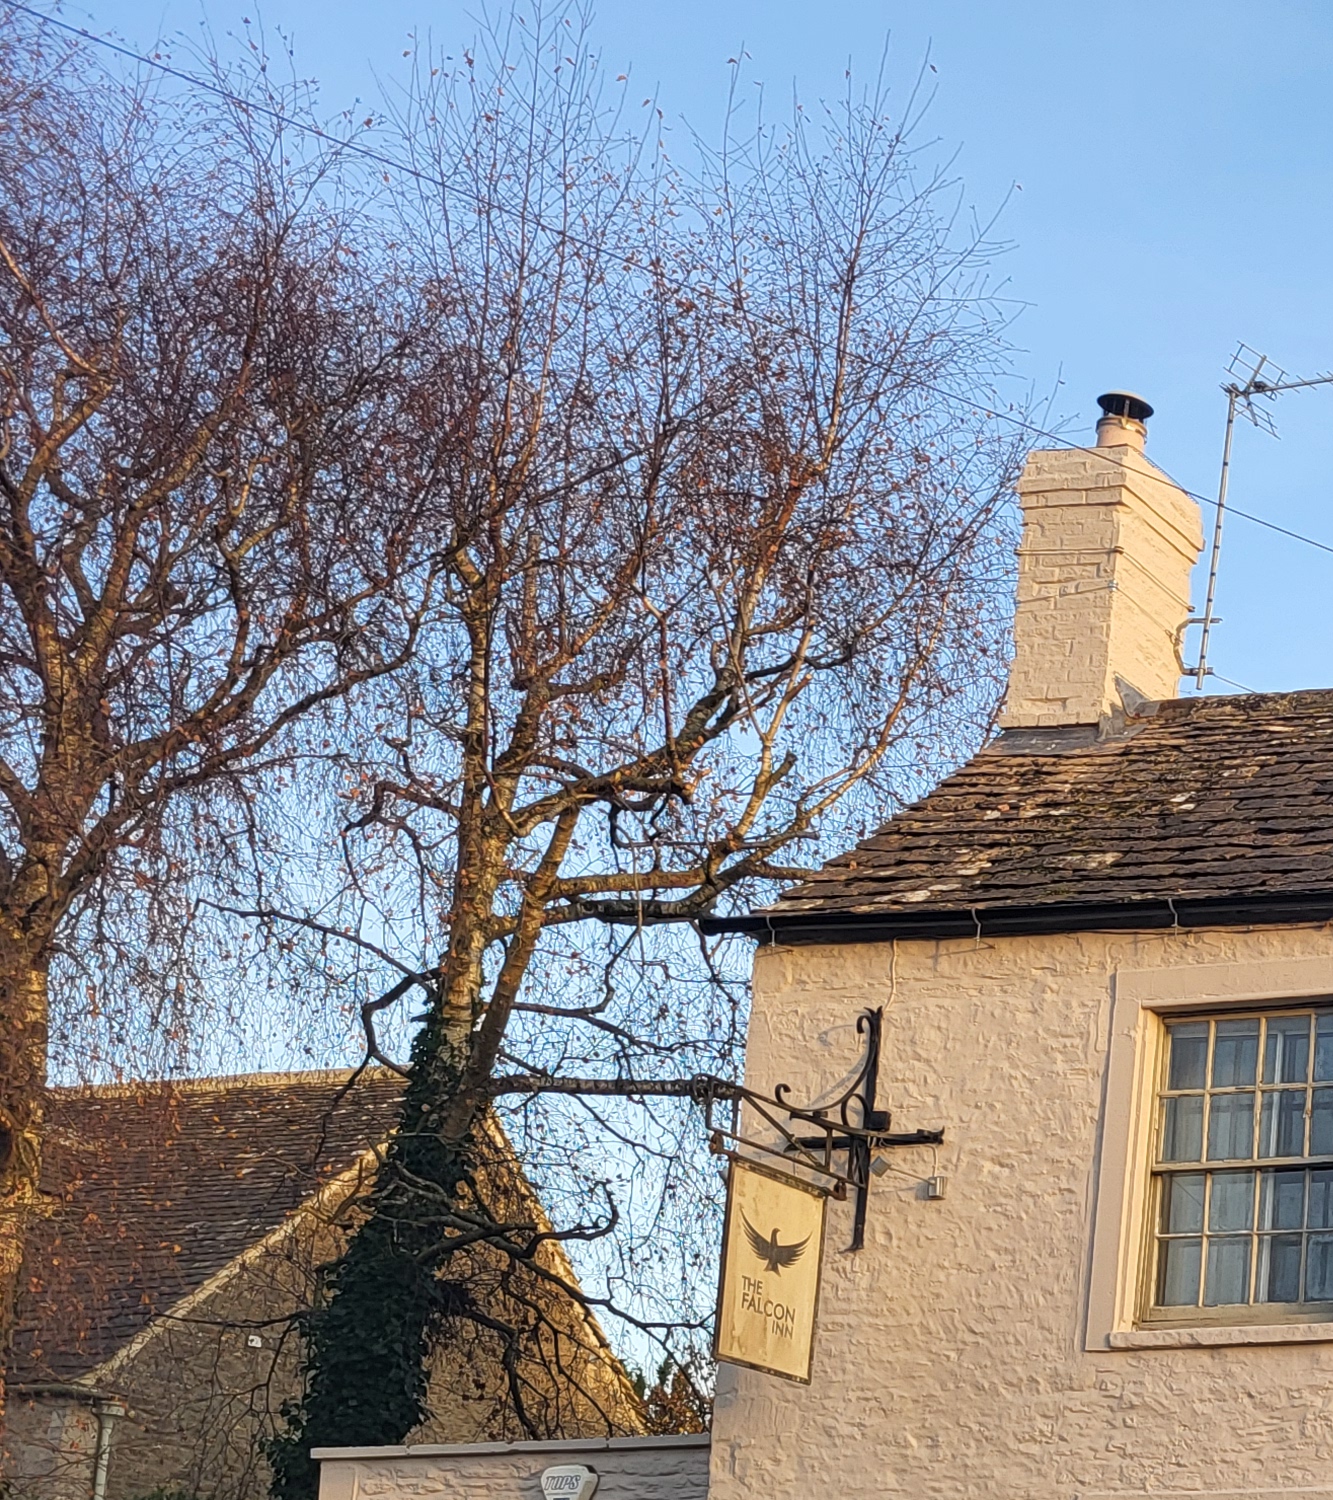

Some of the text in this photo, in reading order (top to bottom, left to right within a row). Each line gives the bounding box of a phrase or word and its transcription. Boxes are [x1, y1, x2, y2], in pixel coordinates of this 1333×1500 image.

[742, 1275, 763, 1296] THE
[742, 1292, 796, 1326] FALCON
[772, 1320, 794, 1340] INN
